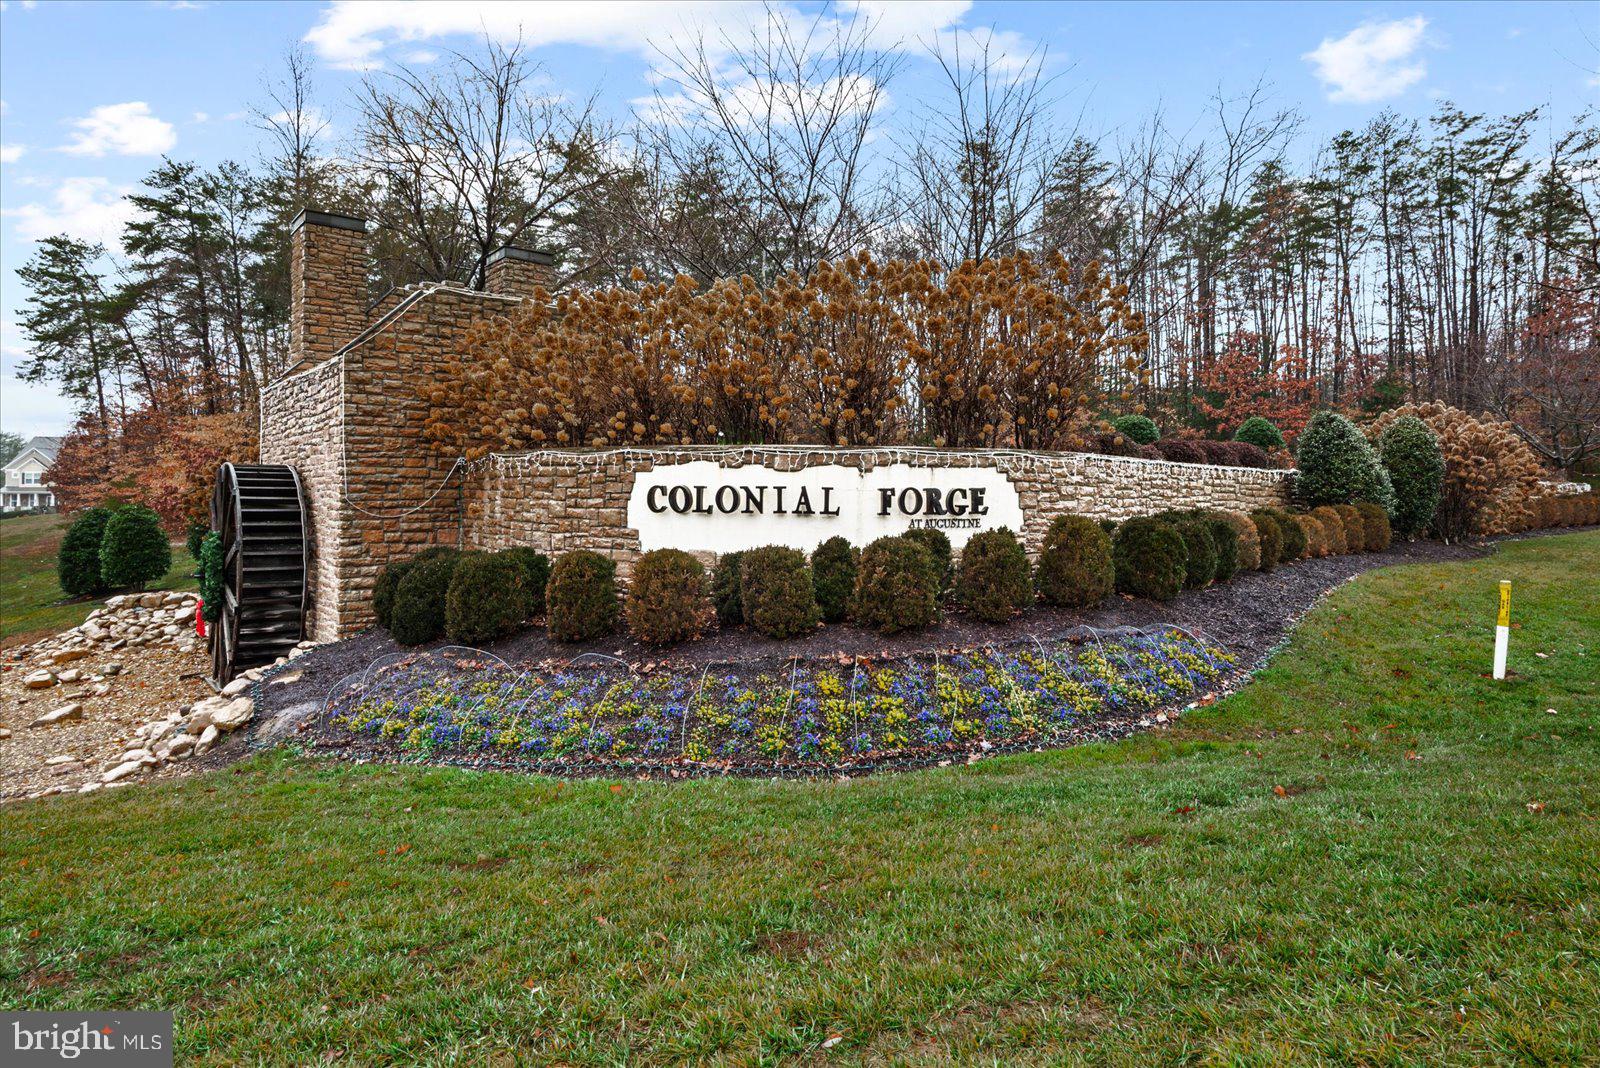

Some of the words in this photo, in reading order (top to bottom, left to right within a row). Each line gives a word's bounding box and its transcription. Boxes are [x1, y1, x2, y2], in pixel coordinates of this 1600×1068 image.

[647, 485, 840, 516] COLONIAL
[878, 487, 988, 516] FORGE
[908, 518, 922, 529] AT
[924, 518, 982, 529] AUGUSTINE
